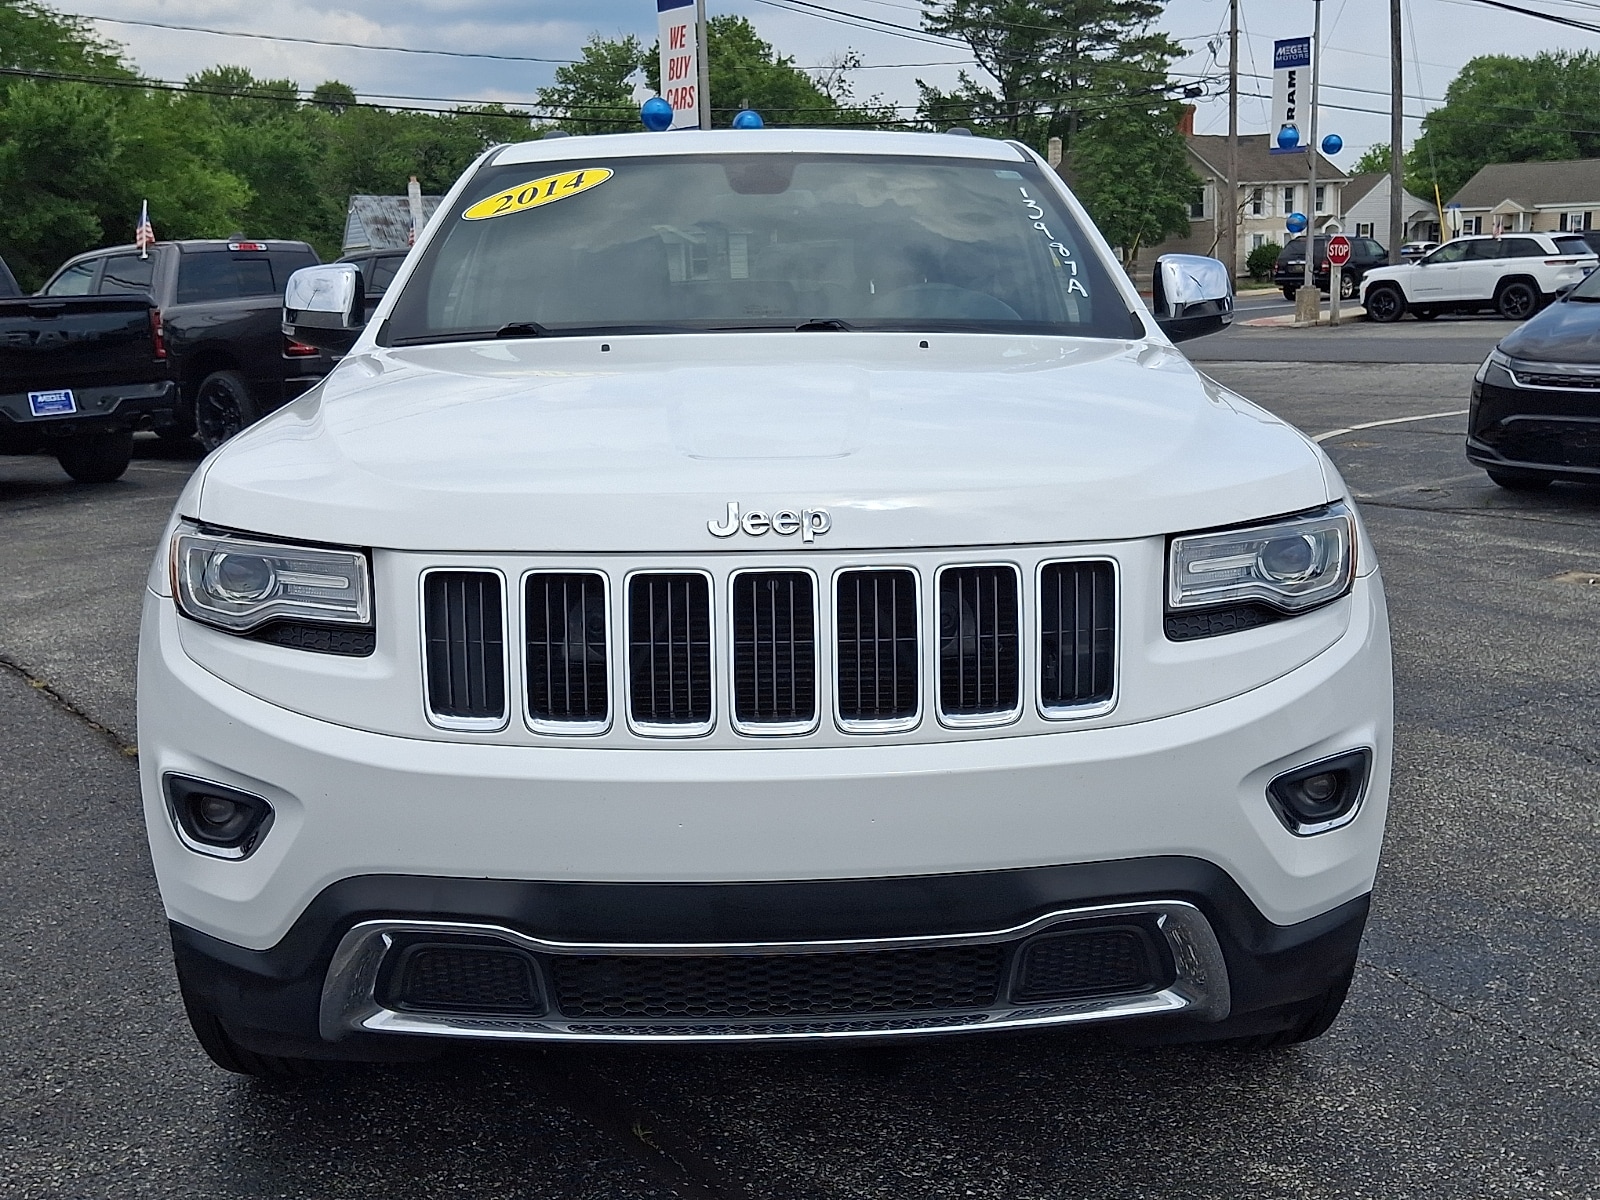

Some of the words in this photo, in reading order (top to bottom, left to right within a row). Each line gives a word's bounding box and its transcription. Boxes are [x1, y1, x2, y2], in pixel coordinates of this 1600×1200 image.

[670, 24, 687, 50] WE
[1276, 43, 1309, 56] MEGEE
[668, 55, 691, 81] BUY
[1275, 52, 1309, 62] MOTORS
[666, 85, 695, 111] CARS
[1286, 70, 1296, 121] RAM
[492, 171, 585, 215] 2014
[1020, 187, 1088, 298] 13987A
[1329, 244, 1349, 257] STOP
[706, 501, 833, 544] Jeep
